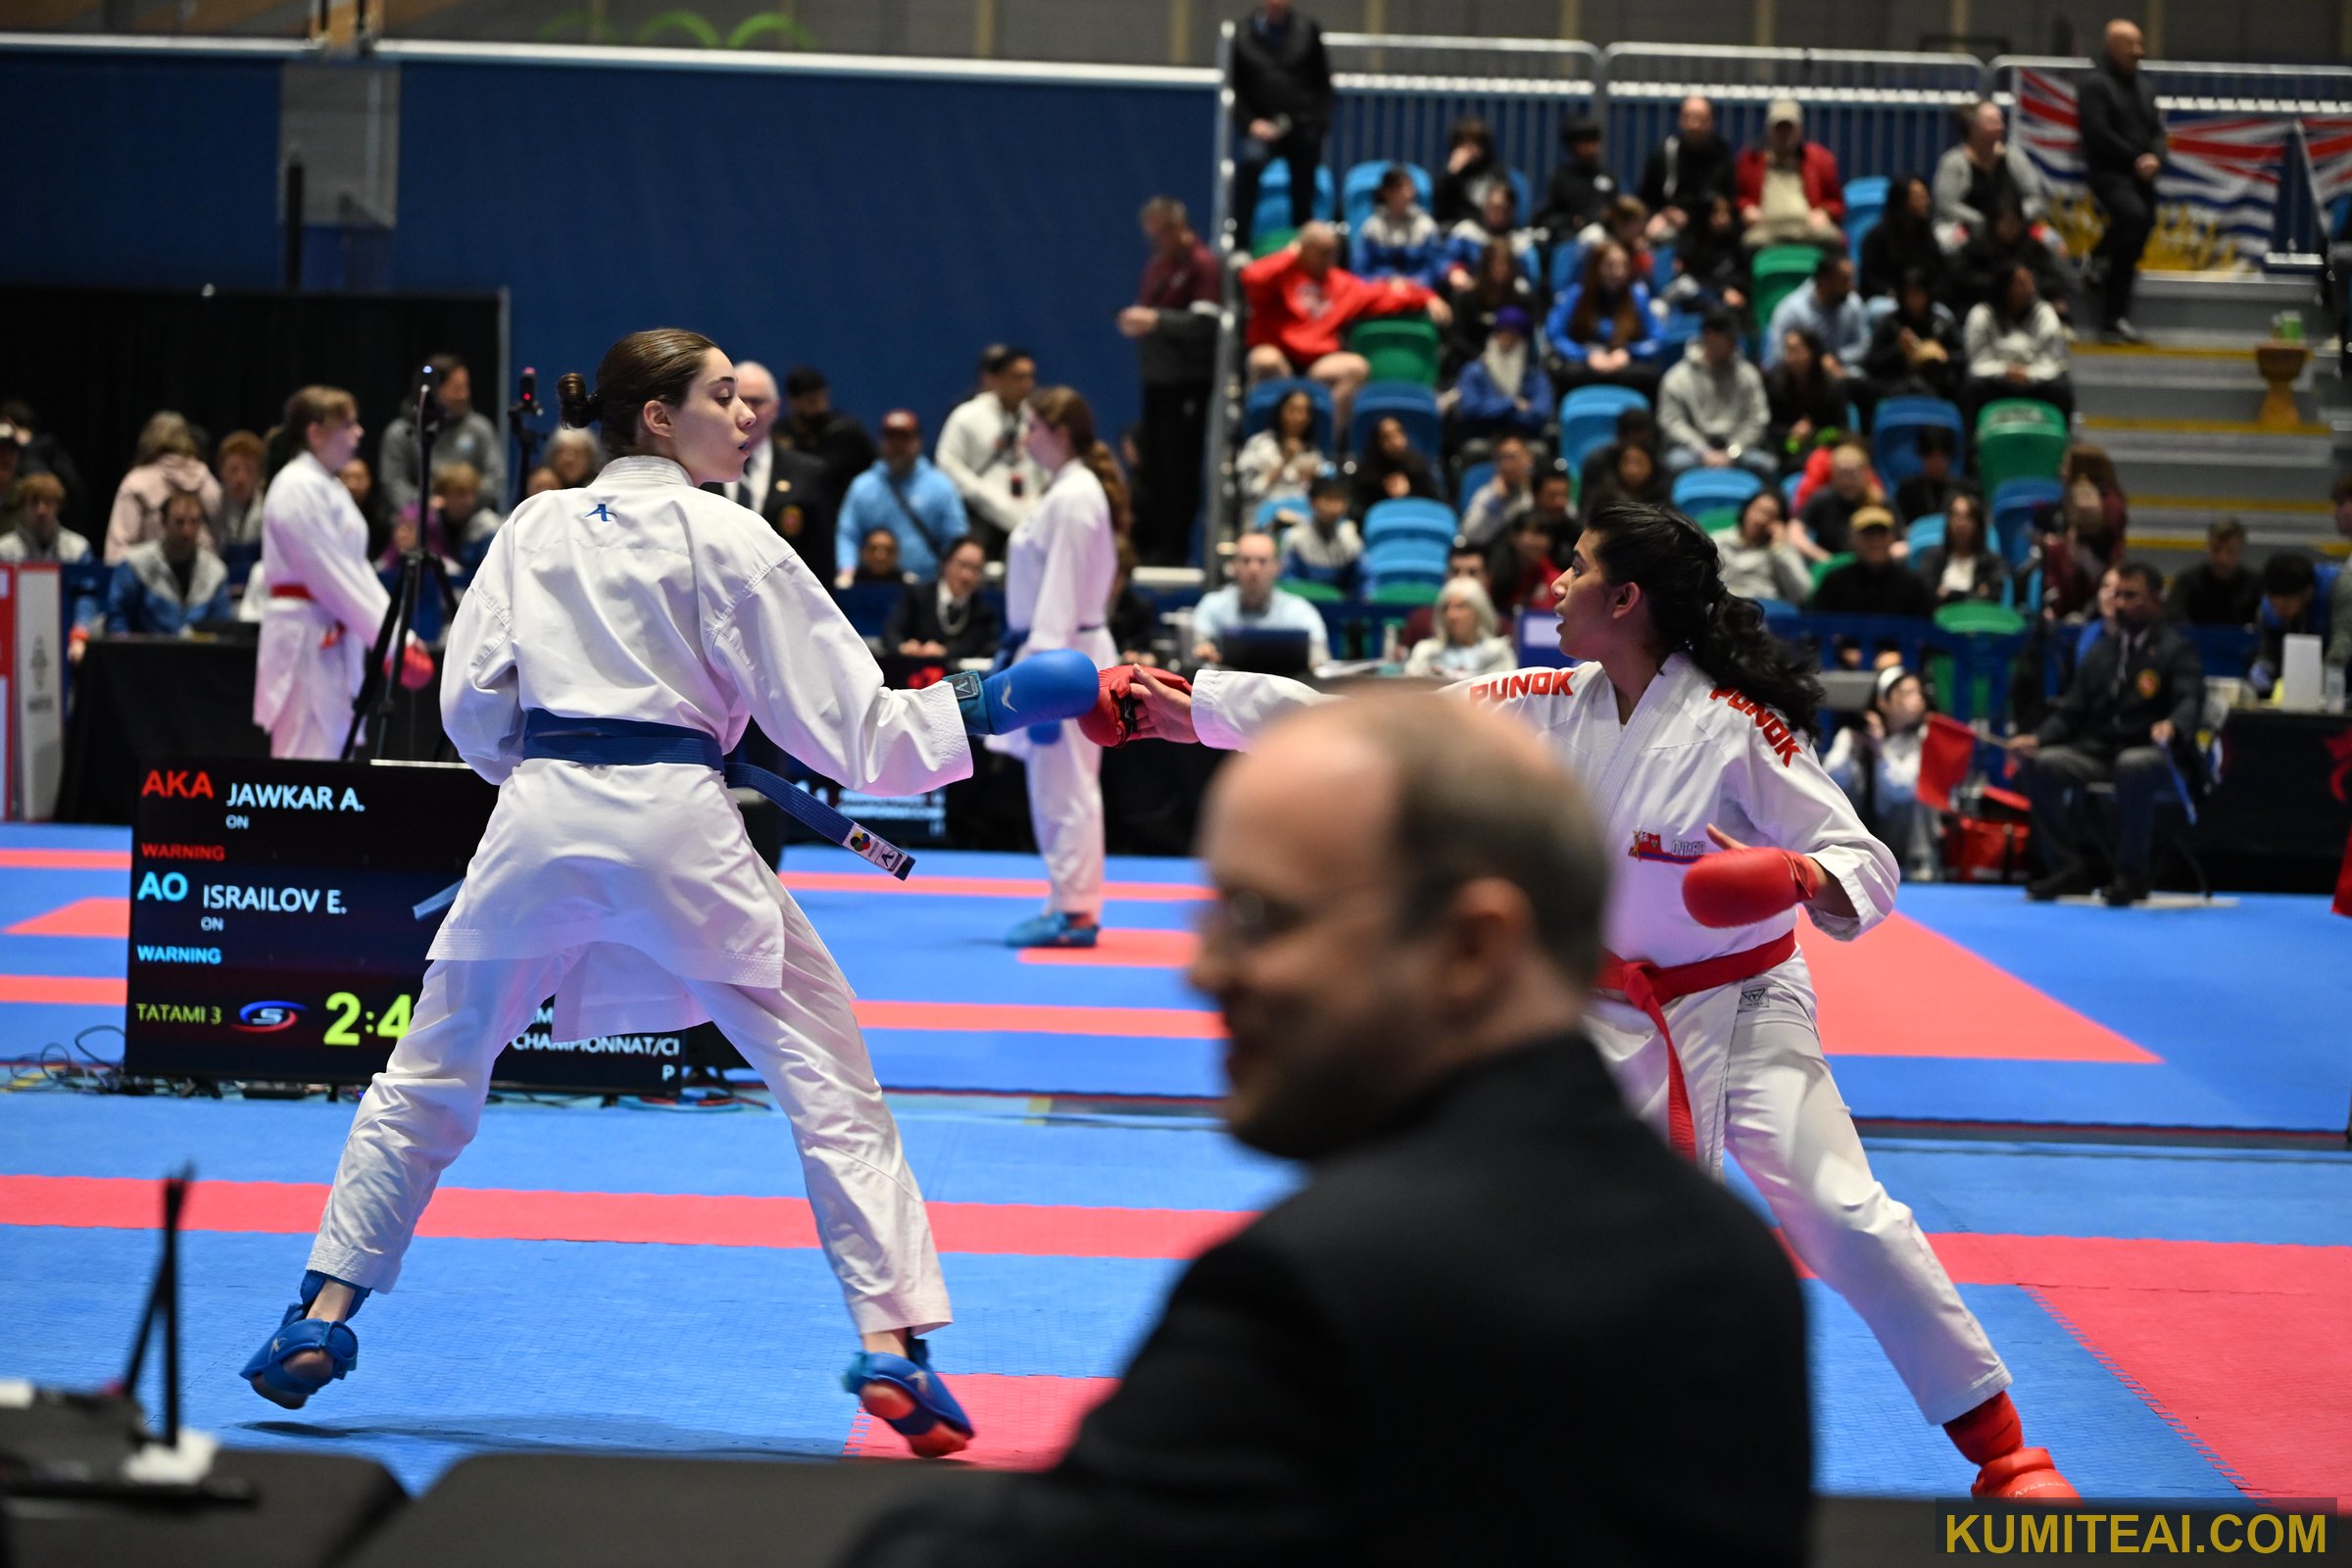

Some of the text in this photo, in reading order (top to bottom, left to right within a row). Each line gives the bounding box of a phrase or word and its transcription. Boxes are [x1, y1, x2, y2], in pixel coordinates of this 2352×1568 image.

[1470, 671, 1575, 708] PUNOK
[141, 769, 214, 799] AKA
[225, 783, 366, 812] JAWKAR A.
[225, 814, 249, 830] ON
[141, 843, 225, 861] WARNING
[137, 871, 189, 902] AO
[203, 884, 348, 914] ISRAILOV E.
[200, 916, 224, 931] ON
[137, 945, 222, 964] WARNING
[136, 1004, 222, 1025] TATAMI 3
[661, 1064, 676, 1082] P
